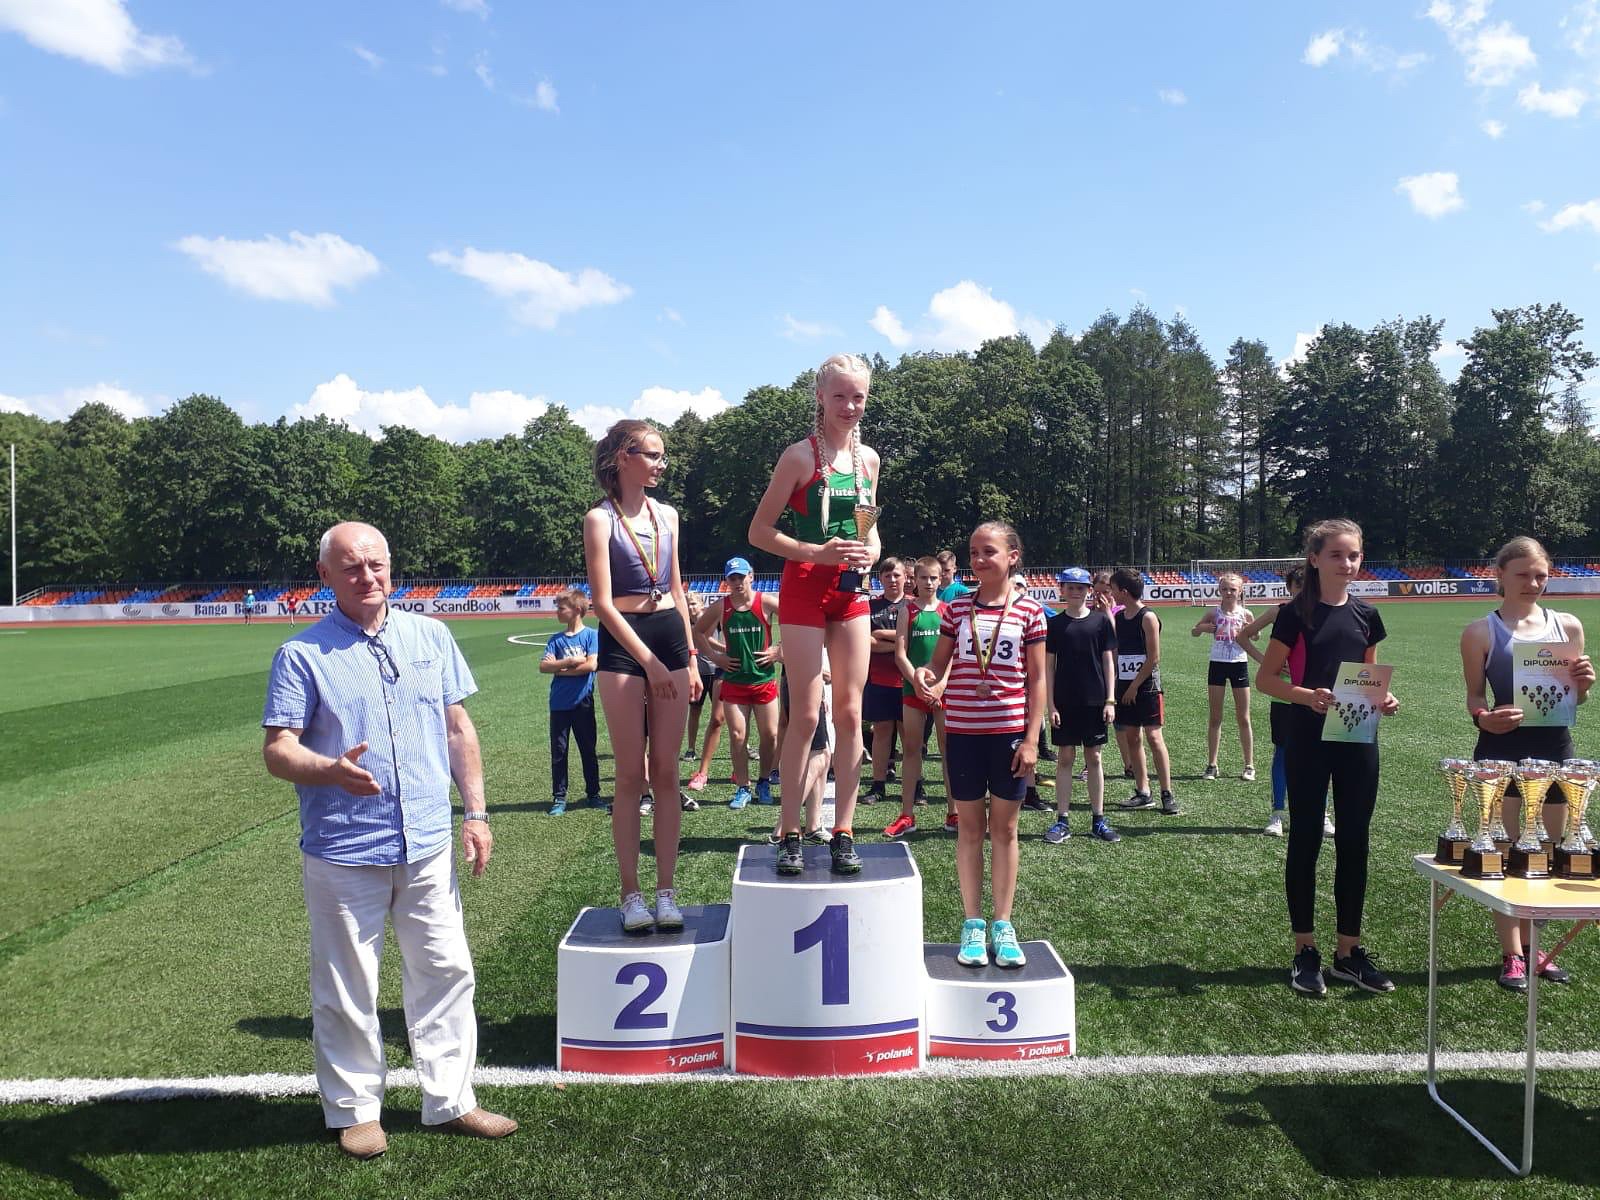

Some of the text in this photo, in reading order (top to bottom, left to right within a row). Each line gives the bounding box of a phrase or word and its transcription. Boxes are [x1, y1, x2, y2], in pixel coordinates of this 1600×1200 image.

[1414, 581, 1458, 594] voltas
[194, 603, 227, 616] Banga
[432, 599, 501, 613] ScandBook
[1121, 661, 1144, 673] 142
[1523, 659, 1569, 667] DIPLOMAS
[1343, 678, 1382, 688] DIPLOMAS
[793, 904, 850, 1006] 1
[613, 961, 668, 1030] 2
[985, 991, 1019, 1033] 3
[876, 1045, 914, 1063] polanik
[1028, 1042, 1065, 1058] polanik
[678, 1050, 719, 1067] polanik
